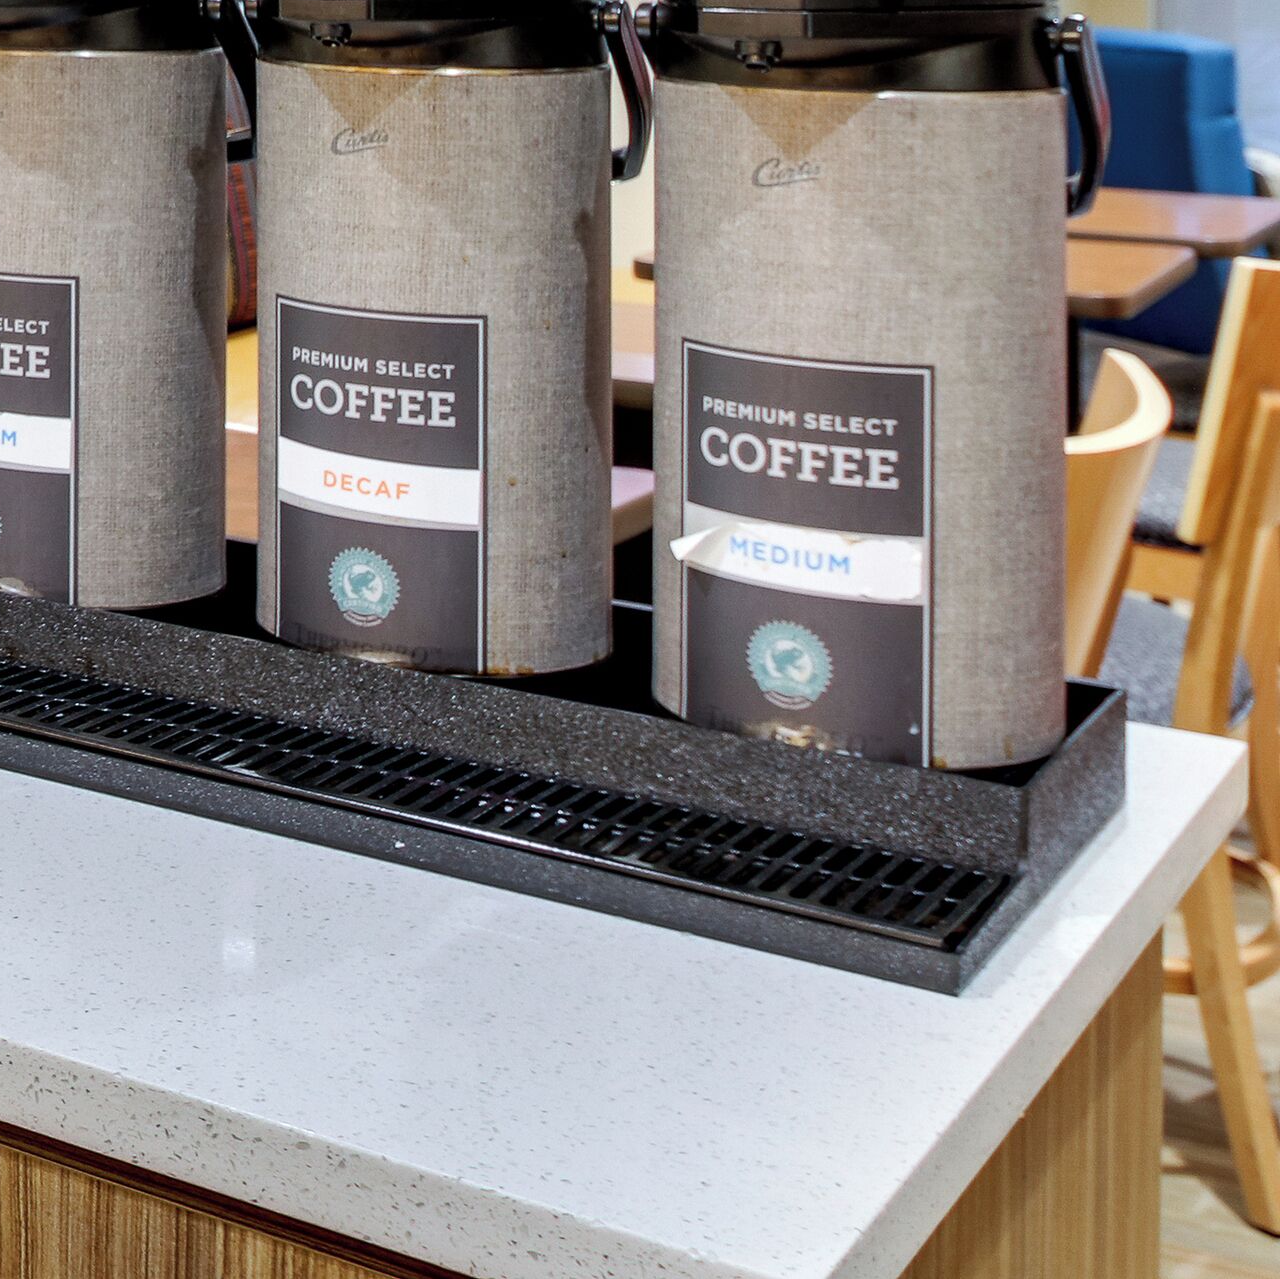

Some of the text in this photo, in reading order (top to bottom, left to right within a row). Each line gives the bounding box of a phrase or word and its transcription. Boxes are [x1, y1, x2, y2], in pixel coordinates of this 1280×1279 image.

[331, 127, 389, 155] Curtis
[751, 157, 820, 187] Curtis
[292, 346, 455, 380] PREMIUM SELECT
[290, 373, 456, 428] COFFEE
[702, 395, 899, 436] PREMIUM SELECT
[700, 425, 899, 490] COFFEE
[323, 470, 411, 500] DECAF
[729, 535, 851, 575] MEDIUM
